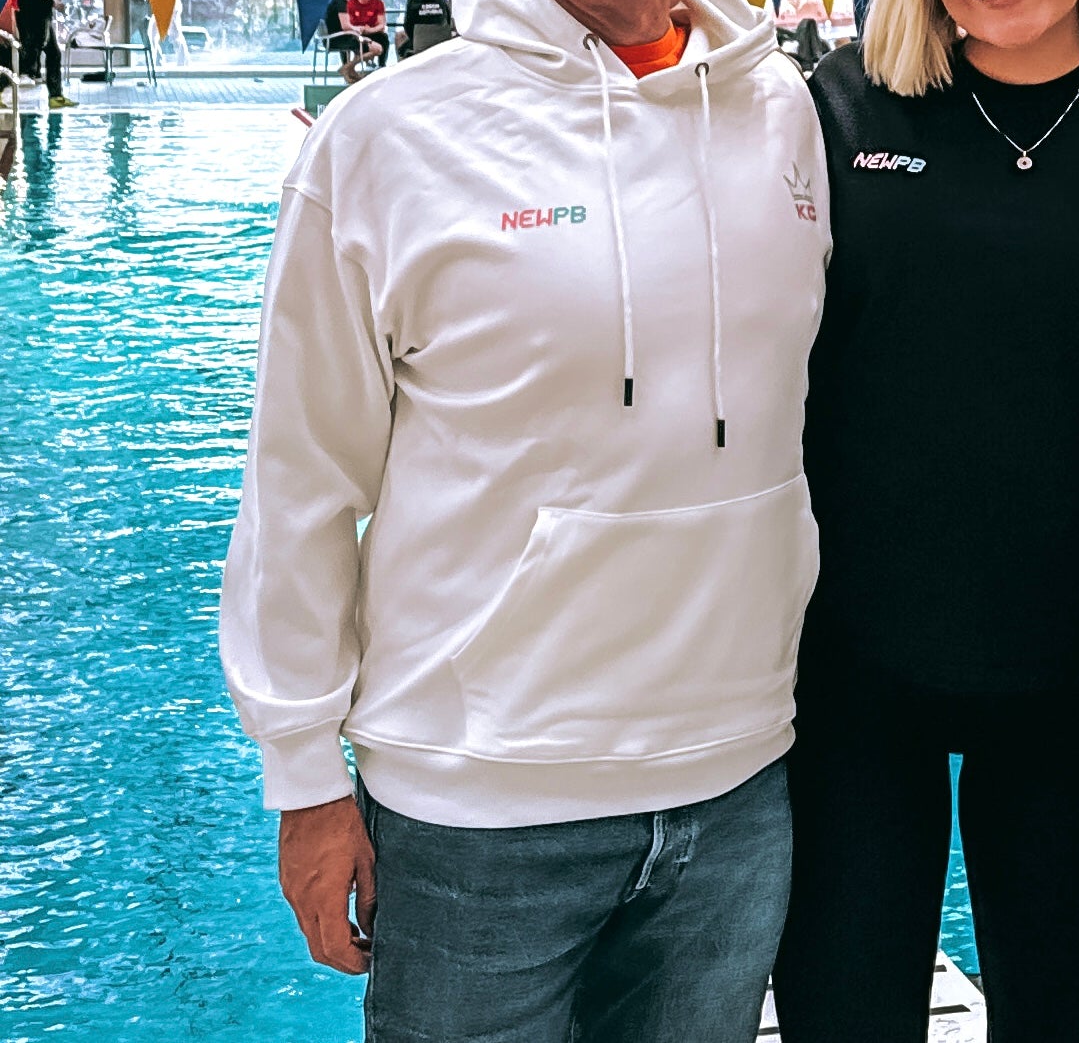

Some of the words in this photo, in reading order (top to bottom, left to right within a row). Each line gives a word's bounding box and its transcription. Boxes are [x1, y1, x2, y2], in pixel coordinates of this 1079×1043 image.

[853, 151, 927, 173] NEWPB
[501, 206, 586, 231] NEWPB
[795, 203, 816, 222] KC
